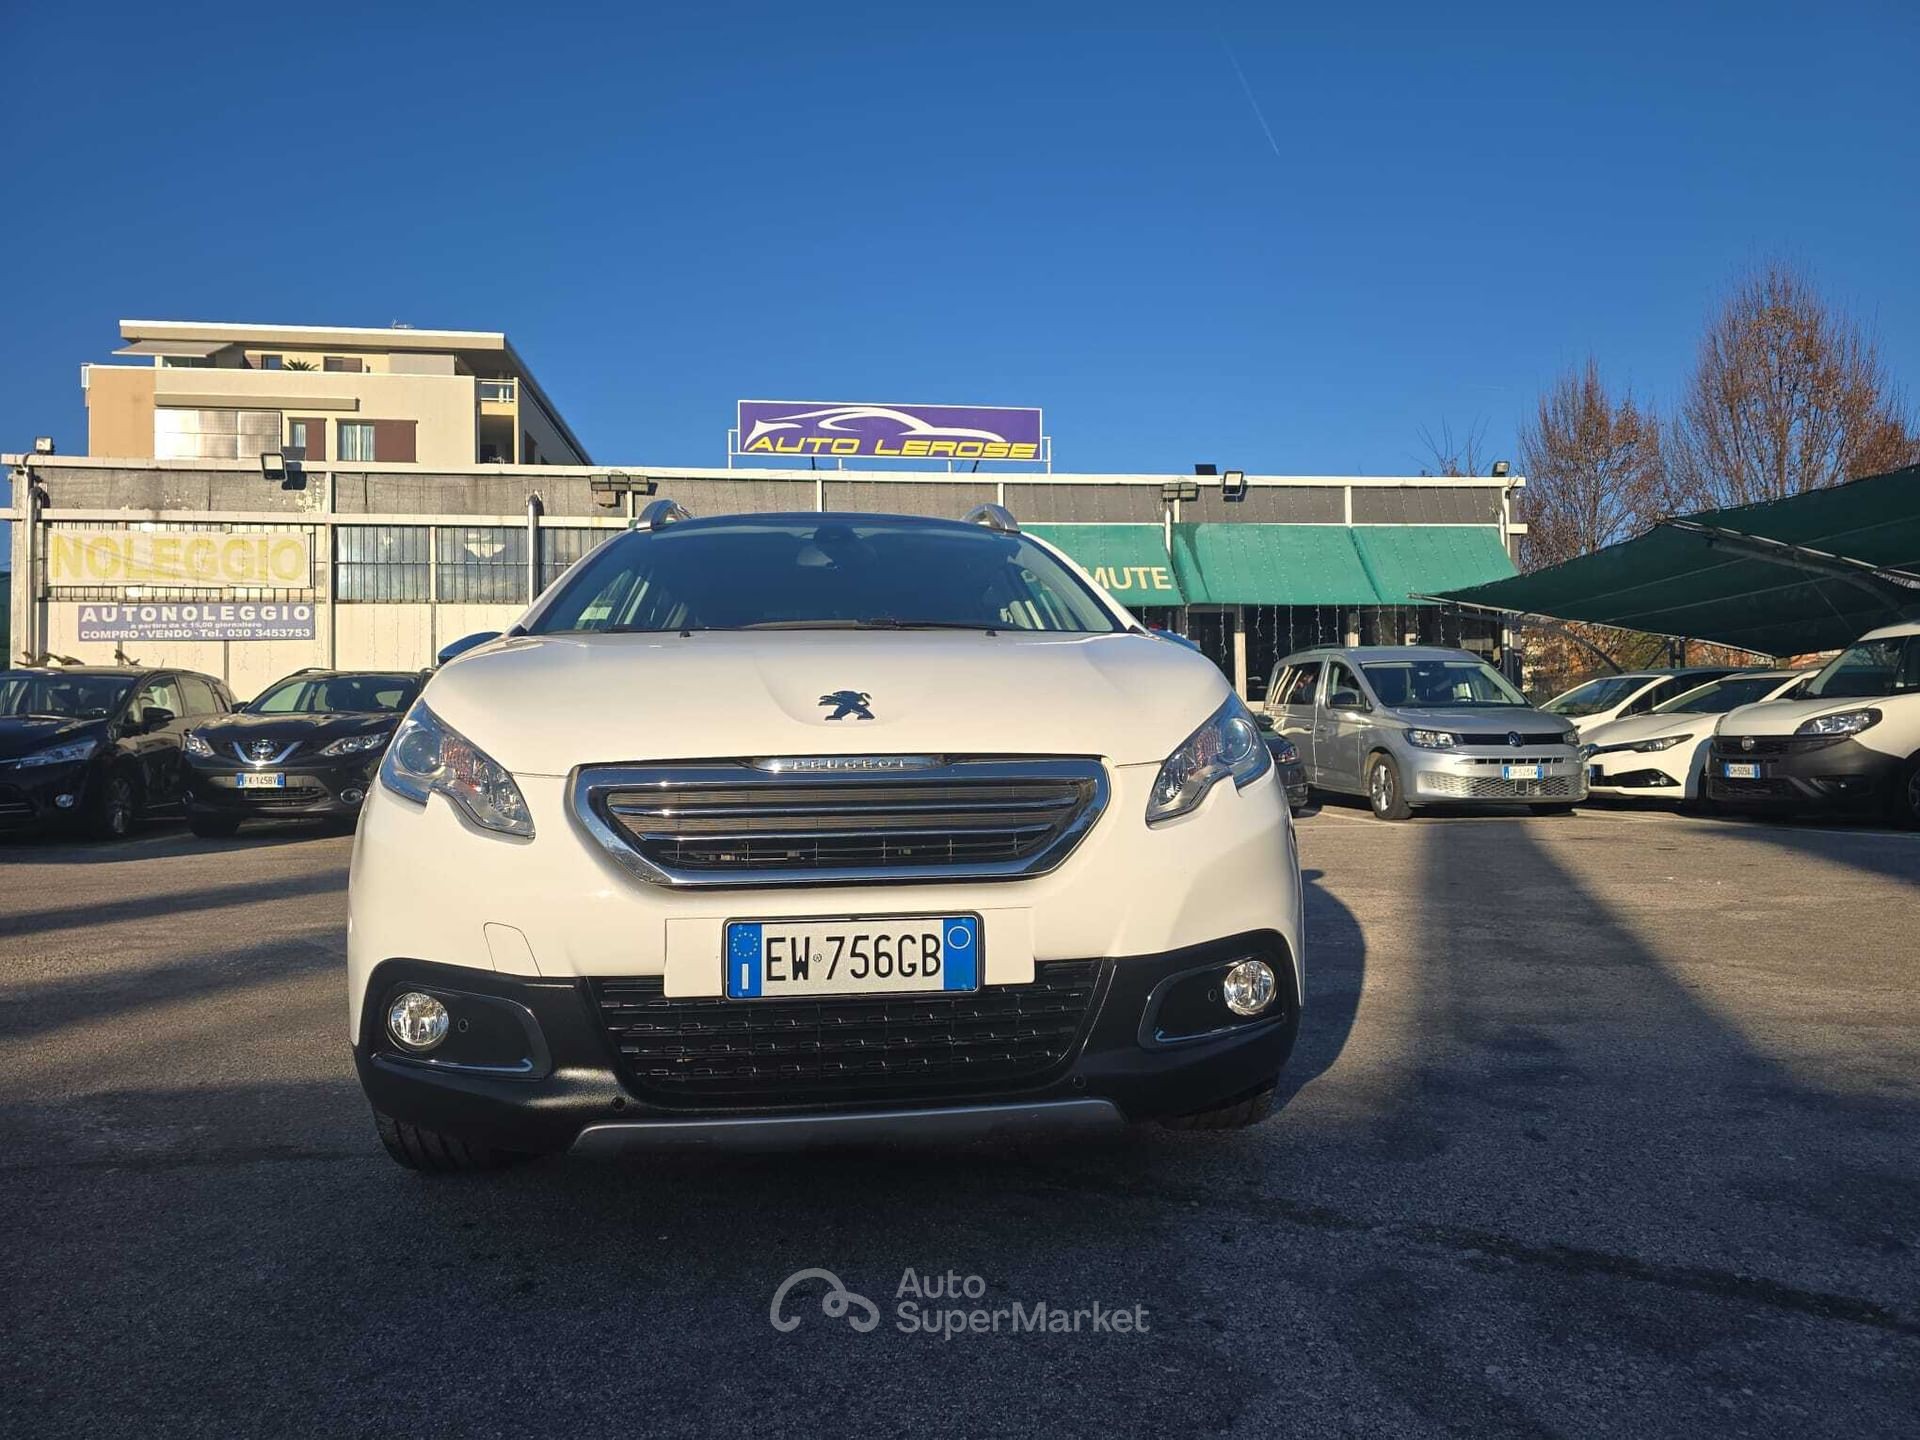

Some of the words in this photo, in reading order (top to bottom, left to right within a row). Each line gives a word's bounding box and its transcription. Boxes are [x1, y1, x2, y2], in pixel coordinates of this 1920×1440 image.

[748, 436, 860, 454] AUTO
[874, 439, 1038, 459] LEROSE
[53, 536, 306, 581] NOLEGGIO
[80, 605, 311, 622] AUTONOLEGGIO
[81, 630, 139, 639] COMPRO
[146, 629, 193, 638] VENDO
[199, 629, 223, 638] Tel.
[227, 629, 251, 638] 030
[255, 628, 311, 637] 3453753
[792, 759, 905, 770] PEUGEOT
[766, 936, 810, 982] EW
[825, 933, 941, 980] 756GB
